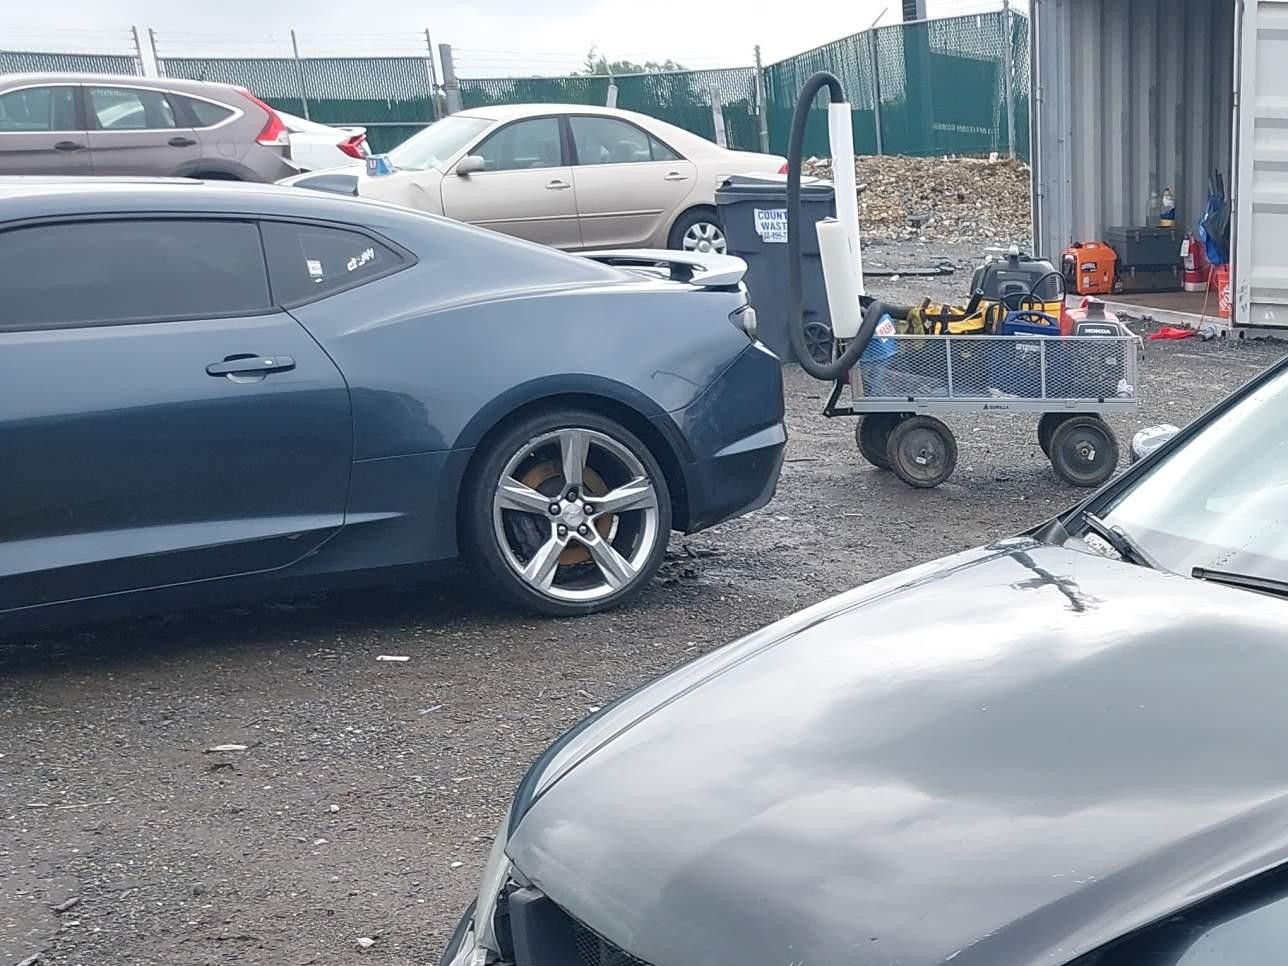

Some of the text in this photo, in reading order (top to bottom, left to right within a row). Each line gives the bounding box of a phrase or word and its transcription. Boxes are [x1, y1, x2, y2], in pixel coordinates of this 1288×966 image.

[757, 211, 788, 220] COUNT
[760, 222, 788, 231] WAST
[1084, 327, 1112, 335] HONDA
